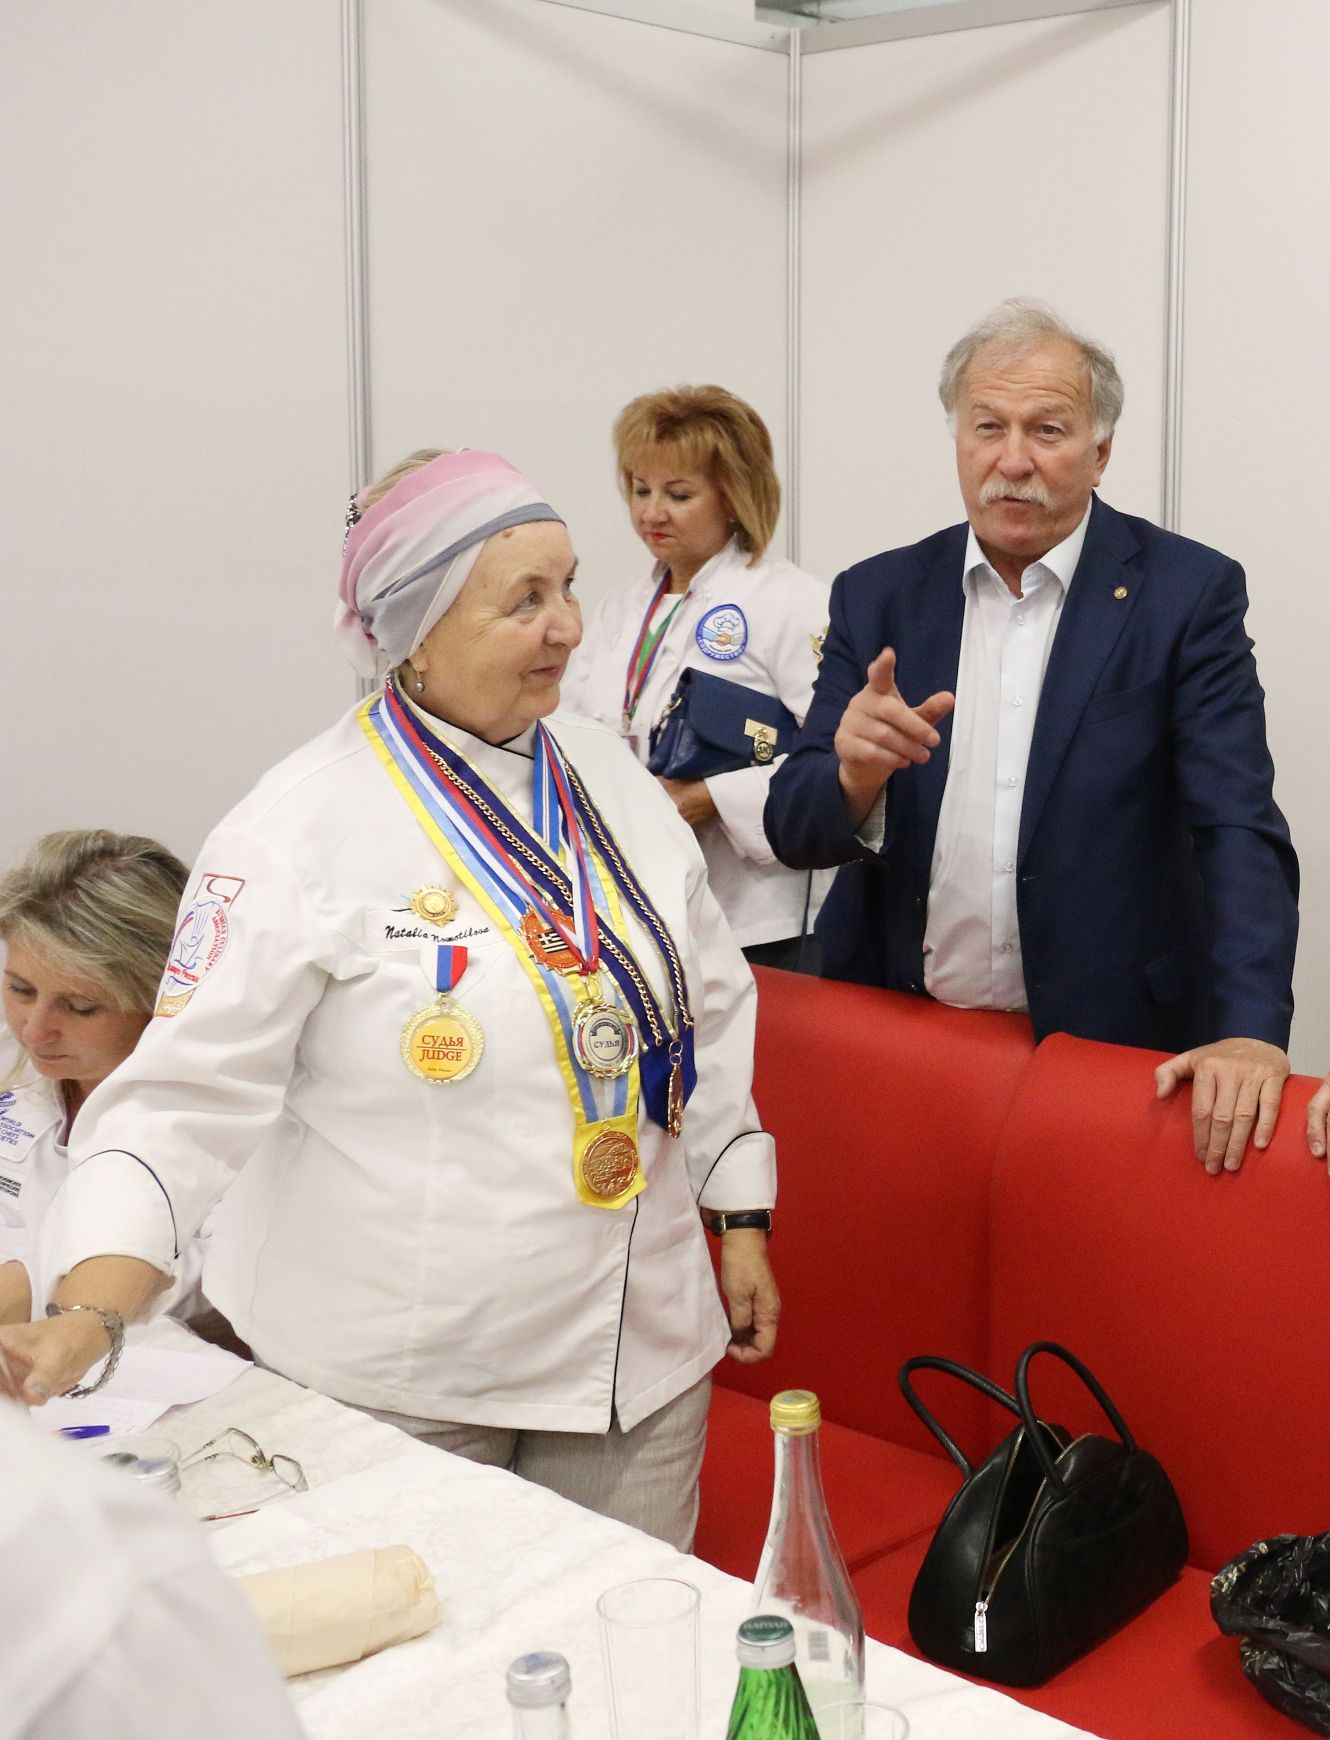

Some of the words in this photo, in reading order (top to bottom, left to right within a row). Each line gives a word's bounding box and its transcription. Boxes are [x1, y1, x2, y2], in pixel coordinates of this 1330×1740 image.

[421, 1034, 465, 1048] СУДЬЯ
[593, 1040, 620, 1049] СУДЬЯ
[419, 1049, 463, 1062] JUDGE
[0, 1122, 35, 1139] SSOCIATION
